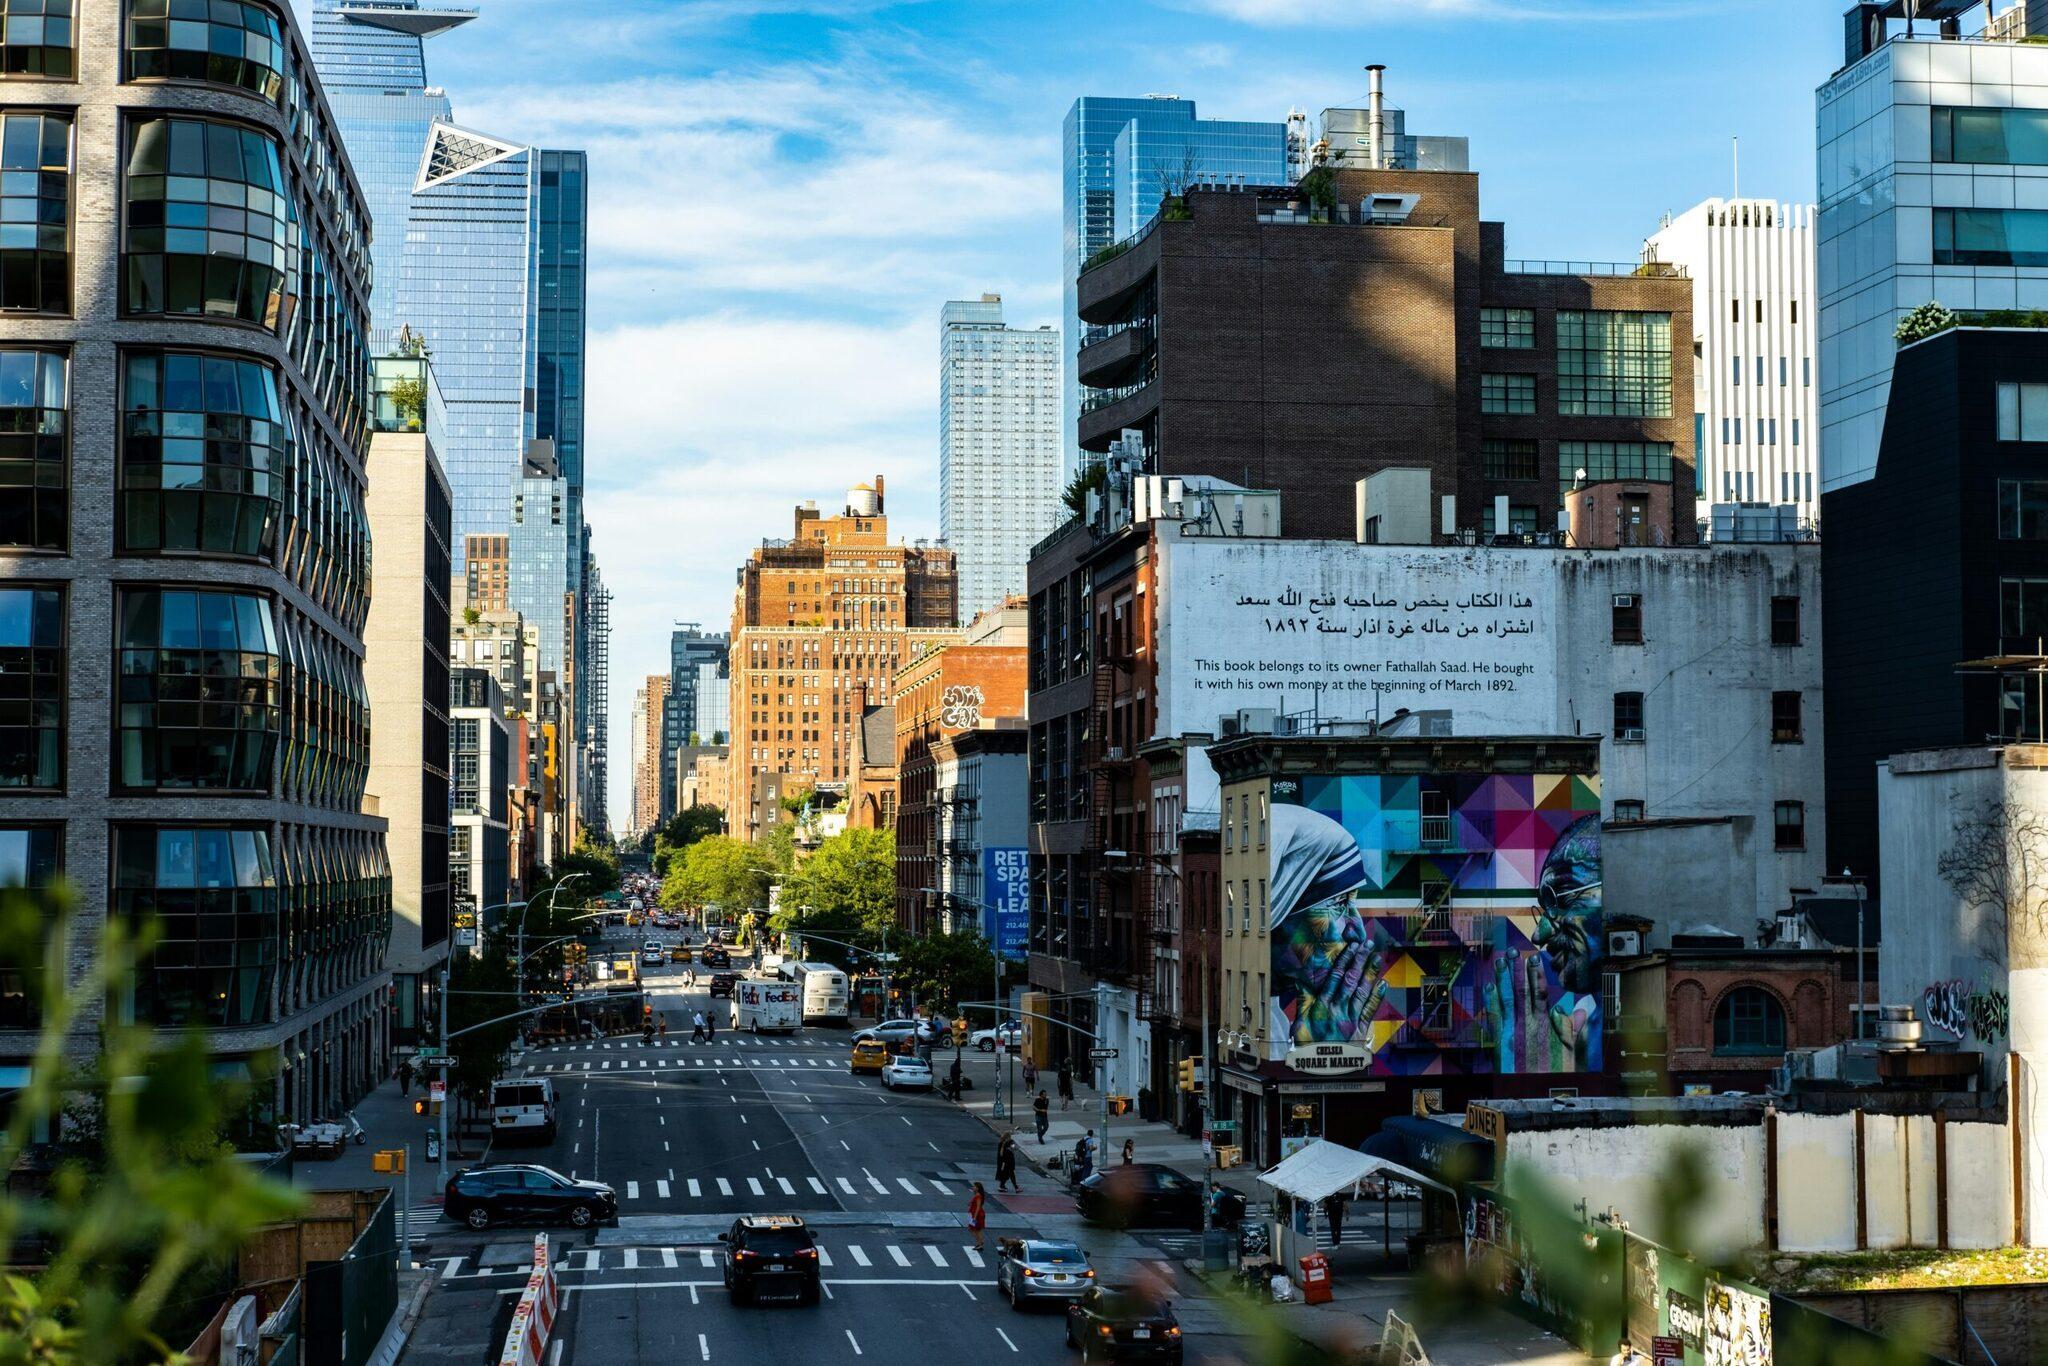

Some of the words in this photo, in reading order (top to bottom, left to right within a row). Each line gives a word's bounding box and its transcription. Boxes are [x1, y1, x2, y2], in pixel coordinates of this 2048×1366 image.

[1236, 595, 1270, 606] سعد
[1277, 585, 1301, 606] الله
[1309, 588, 1336, 614] فتح
[1344, 592, 1397, 611] صاحبه
[1405, 594, 1449, 612] يخص
[1456, 592, 1502, 613] الكتاب
[1509, 592, 1532, 608] هذا
[1265, 618, 1308, 633] ١٨٩٢
[1317, 617, 1347, 633] سنة
[1352, 619, 1380, 638] اذار
[1388, 620, 1414, 638] غرة
[1421, 618, 1449, 633] ماله
[1457, 622, 1478, 638] من
[1486, 619, 1533, 638] اشتراه
[1194, 659, 1220, 671] This
[1224, 660, 1255, 671] book
[1259, 660, 1304, 674] belongs
[1309, 663, 1321, 671] to
[1326, 661, 1339, 671] its
[1344, 664, 1382, 672] owner
[1386, 661, 1436, 672] Fathallah
[1441, 661, 1469, 672] Saad.
[1473, 662, 1490, 673] He
[1494, 662, 1534, 677] bought
[1195, 678, 1203, 689] it
[1207, 678, 1233, 689] with
[1238, 678, 1253, 689] his
[1288, 681, 1327, 693] money
[1332, 681, 1343, 690] at
[1348, 679, 1367, 691] the
[1371, 680, 1426, 693] beginning
[1430, 679, 1442, 690] of
[1445, 680, 1481, 691] March
[1488, 680, 1516, 692] 1892.
[765, 991, 798, 1003] FedEx
[1316, 1046, 1343, 1055] CHELSEA
[1295, 1058, 1327, 1069] SQUARE
[1329, 1057, 1364, 1068] MARKET
[1468, 1106, 1497, 1137] DINER
